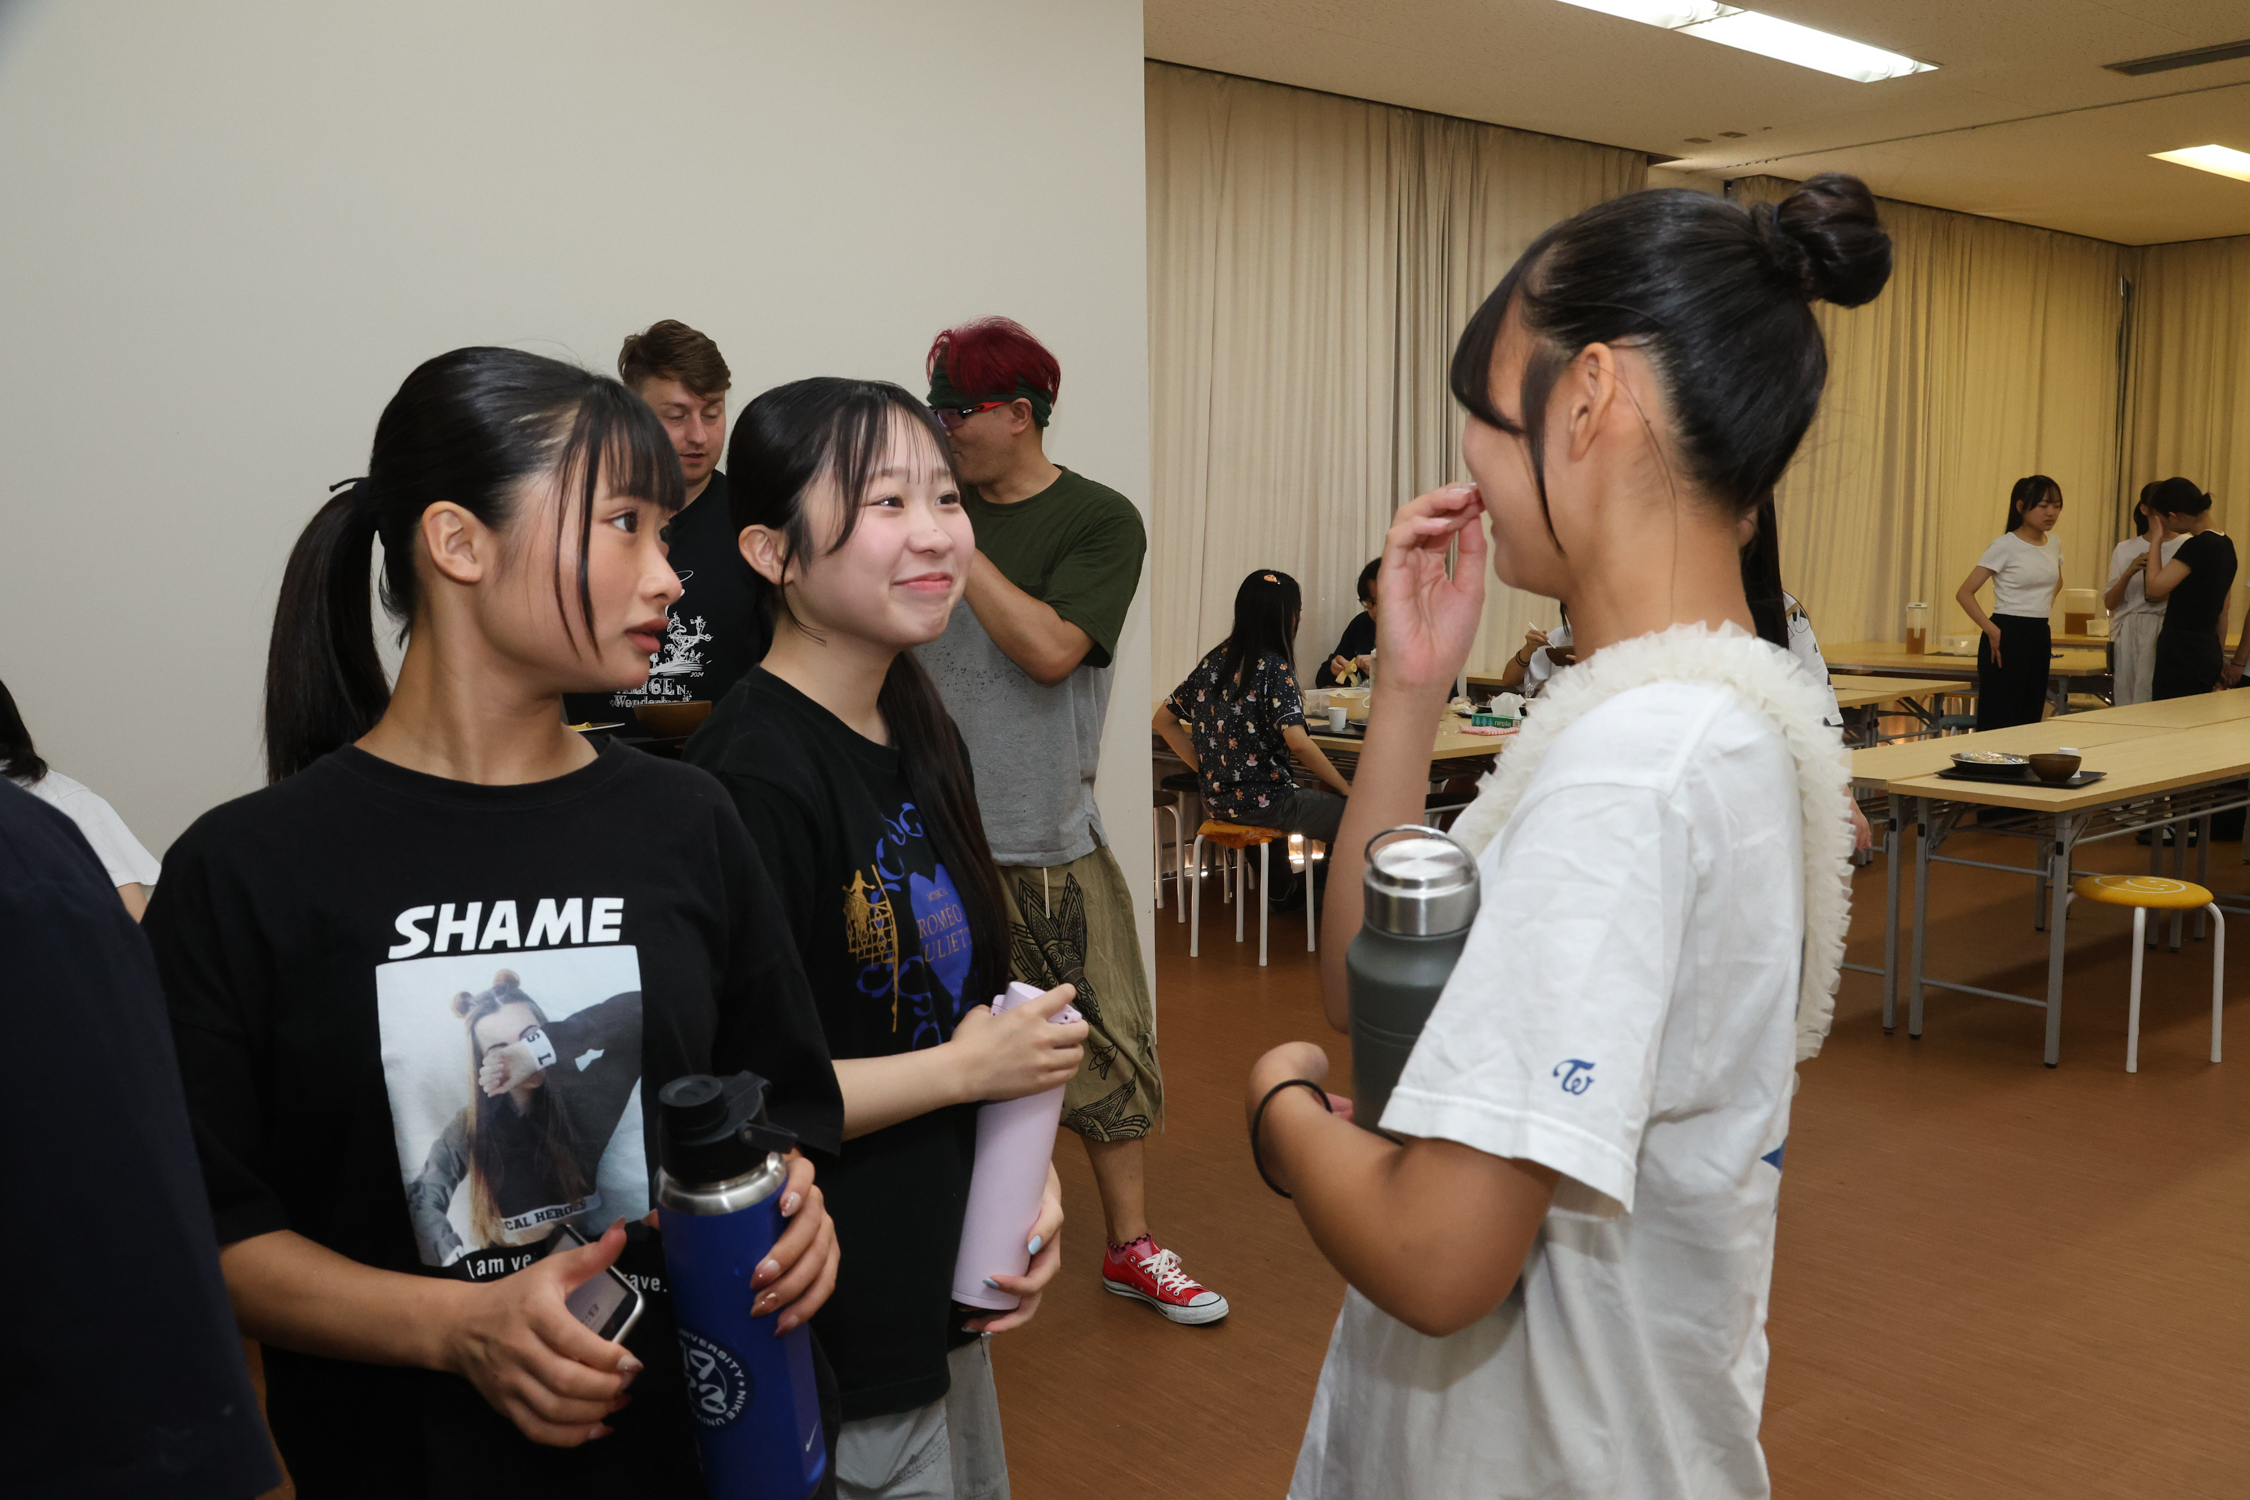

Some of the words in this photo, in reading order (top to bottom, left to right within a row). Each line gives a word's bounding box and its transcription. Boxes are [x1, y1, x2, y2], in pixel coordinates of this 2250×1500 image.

[387, 897, 625, 960] SHAME
[917, 903, 962, 939] ROMÉO
[921, 926, 972, 962] ULIETT
[504, 1216, 532, 1231] CAL
[476, 1257, 504, 1276] am
[511, 1253, 532, 1269] ve
[628, 1273, 668, 1293] ave.
[677, 1327, 744, 1379] NIVERSITY
[725, 1389, 747, 1420] NIKE
